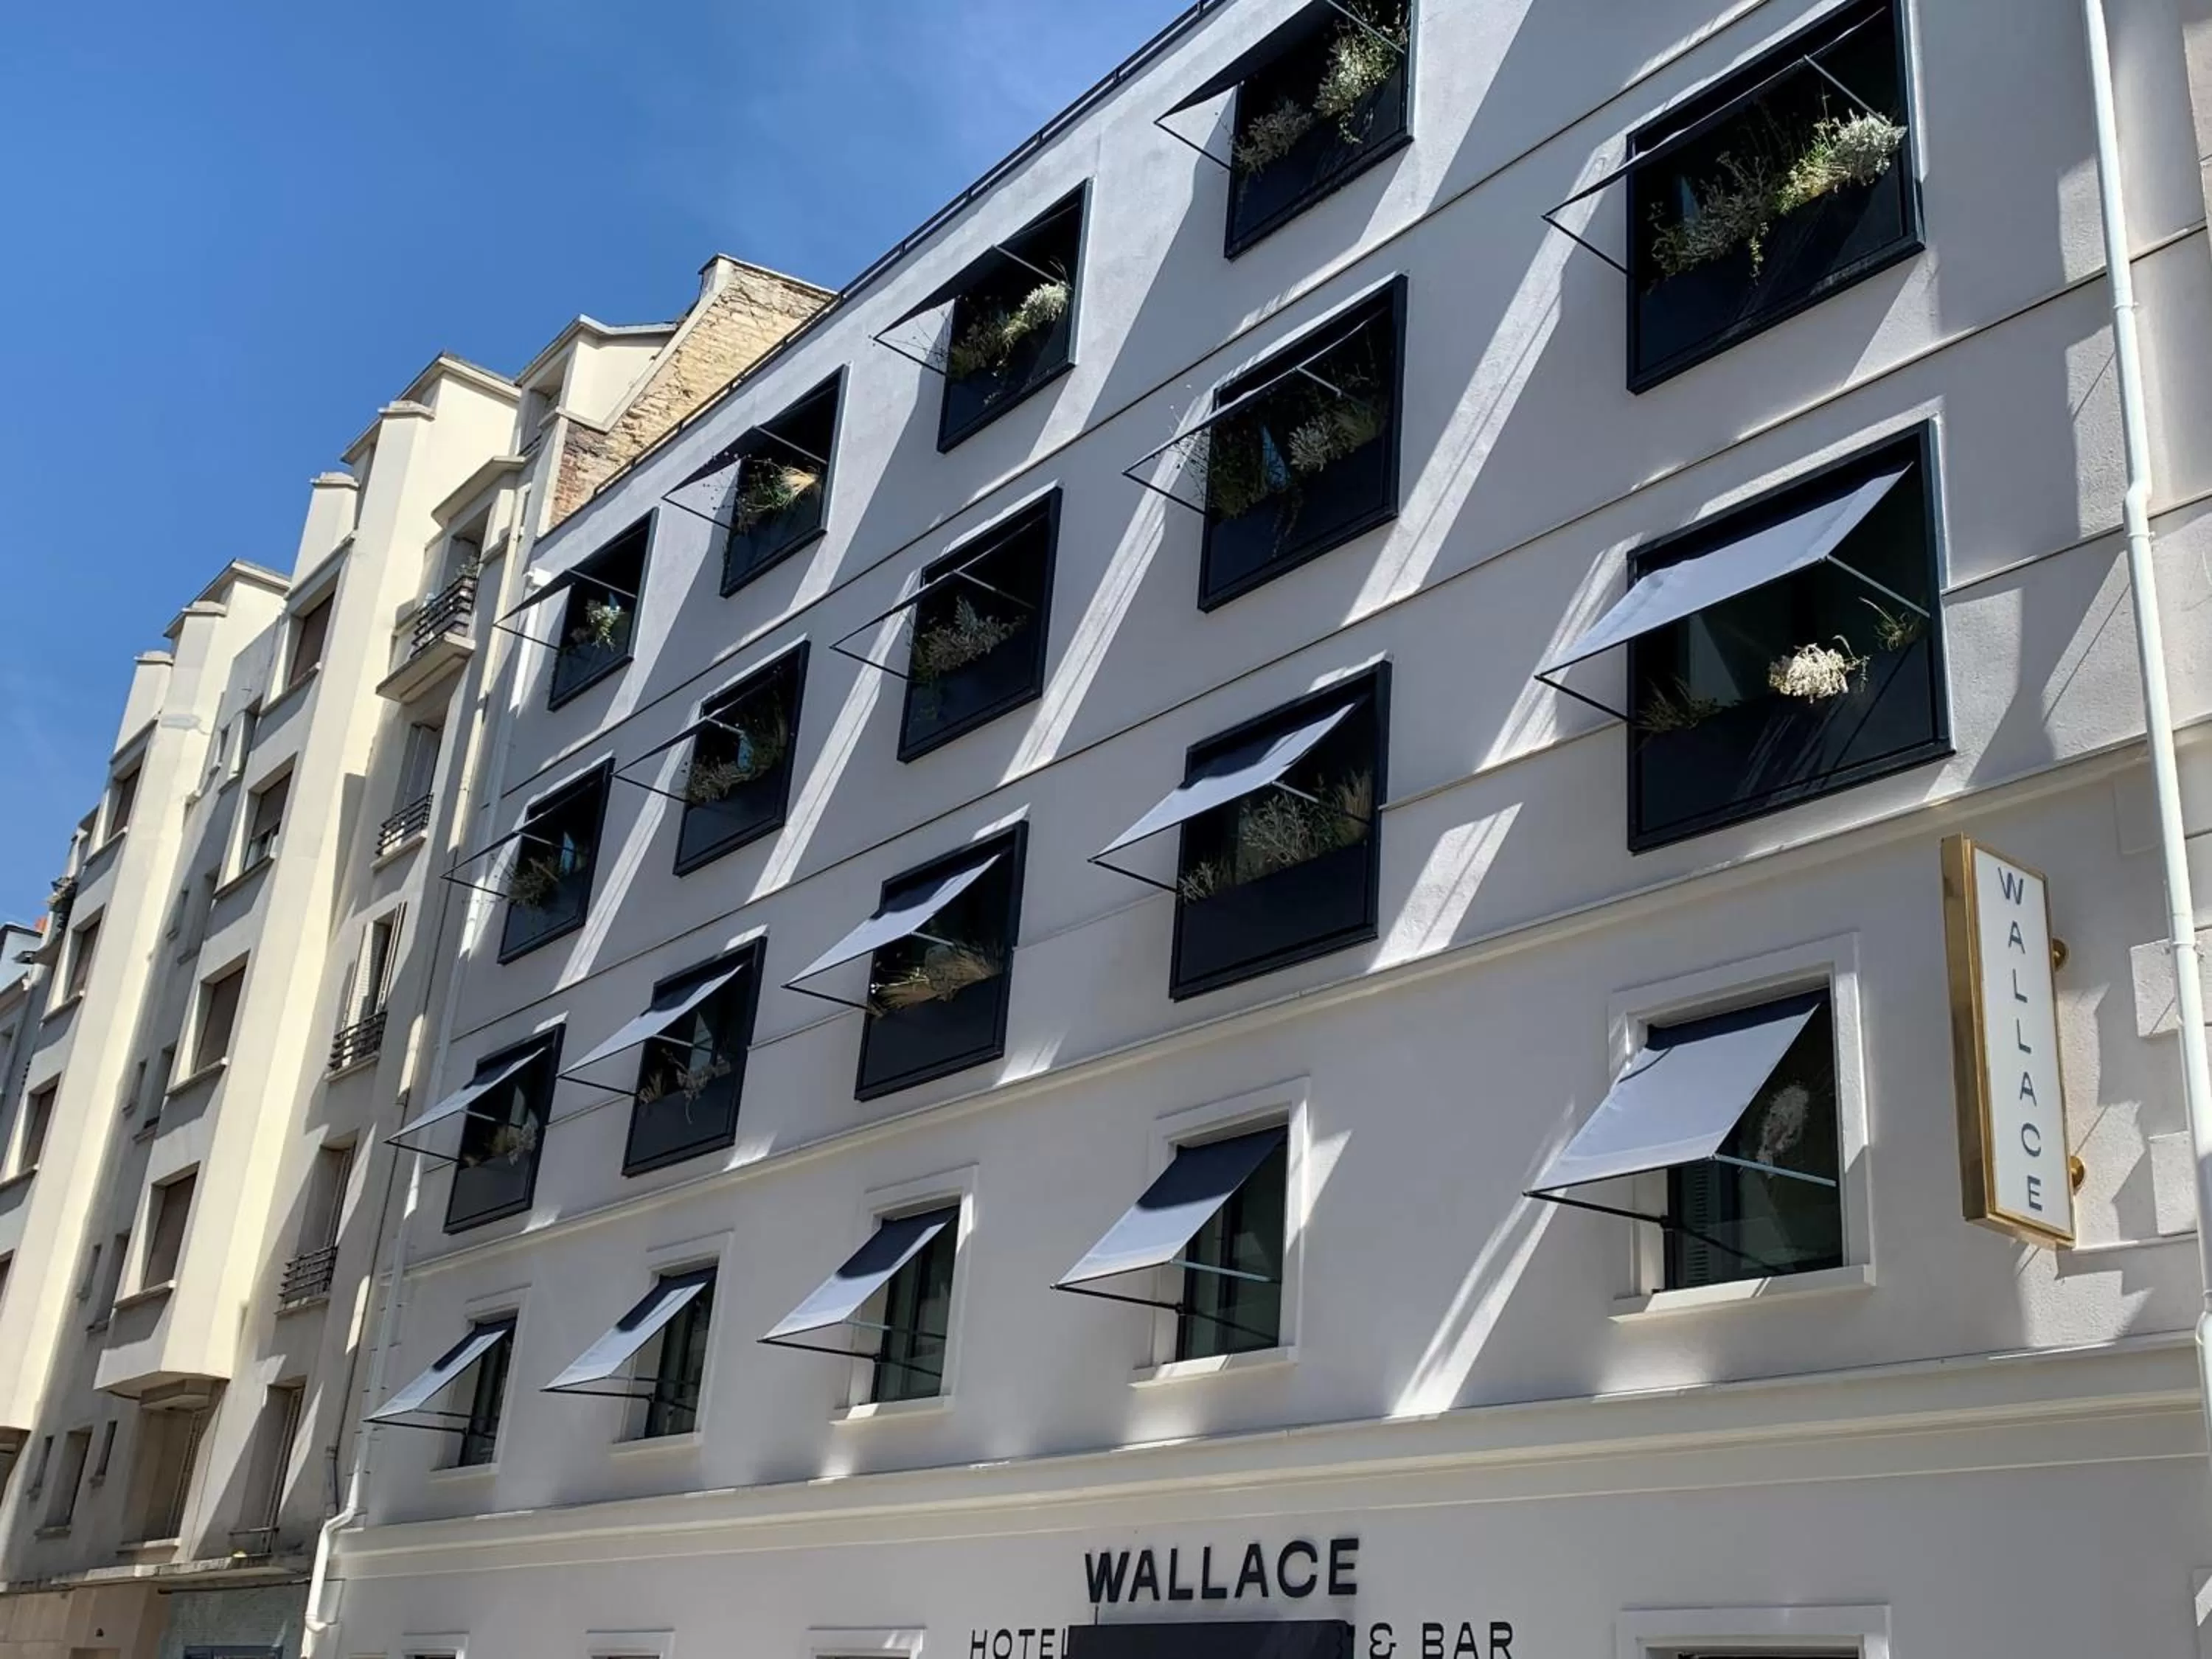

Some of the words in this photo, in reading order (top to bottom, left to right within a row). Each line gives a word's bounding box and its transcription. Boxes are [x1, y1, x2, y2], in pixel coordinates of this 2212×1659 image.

[1997, 865, 2043, 1211] WALLACE
[1084, 1537, 1360, 1604] WALLACE
[1369, 1622, 1397, 1659] &
[1422, 1621, 1513, 1659] BAR
